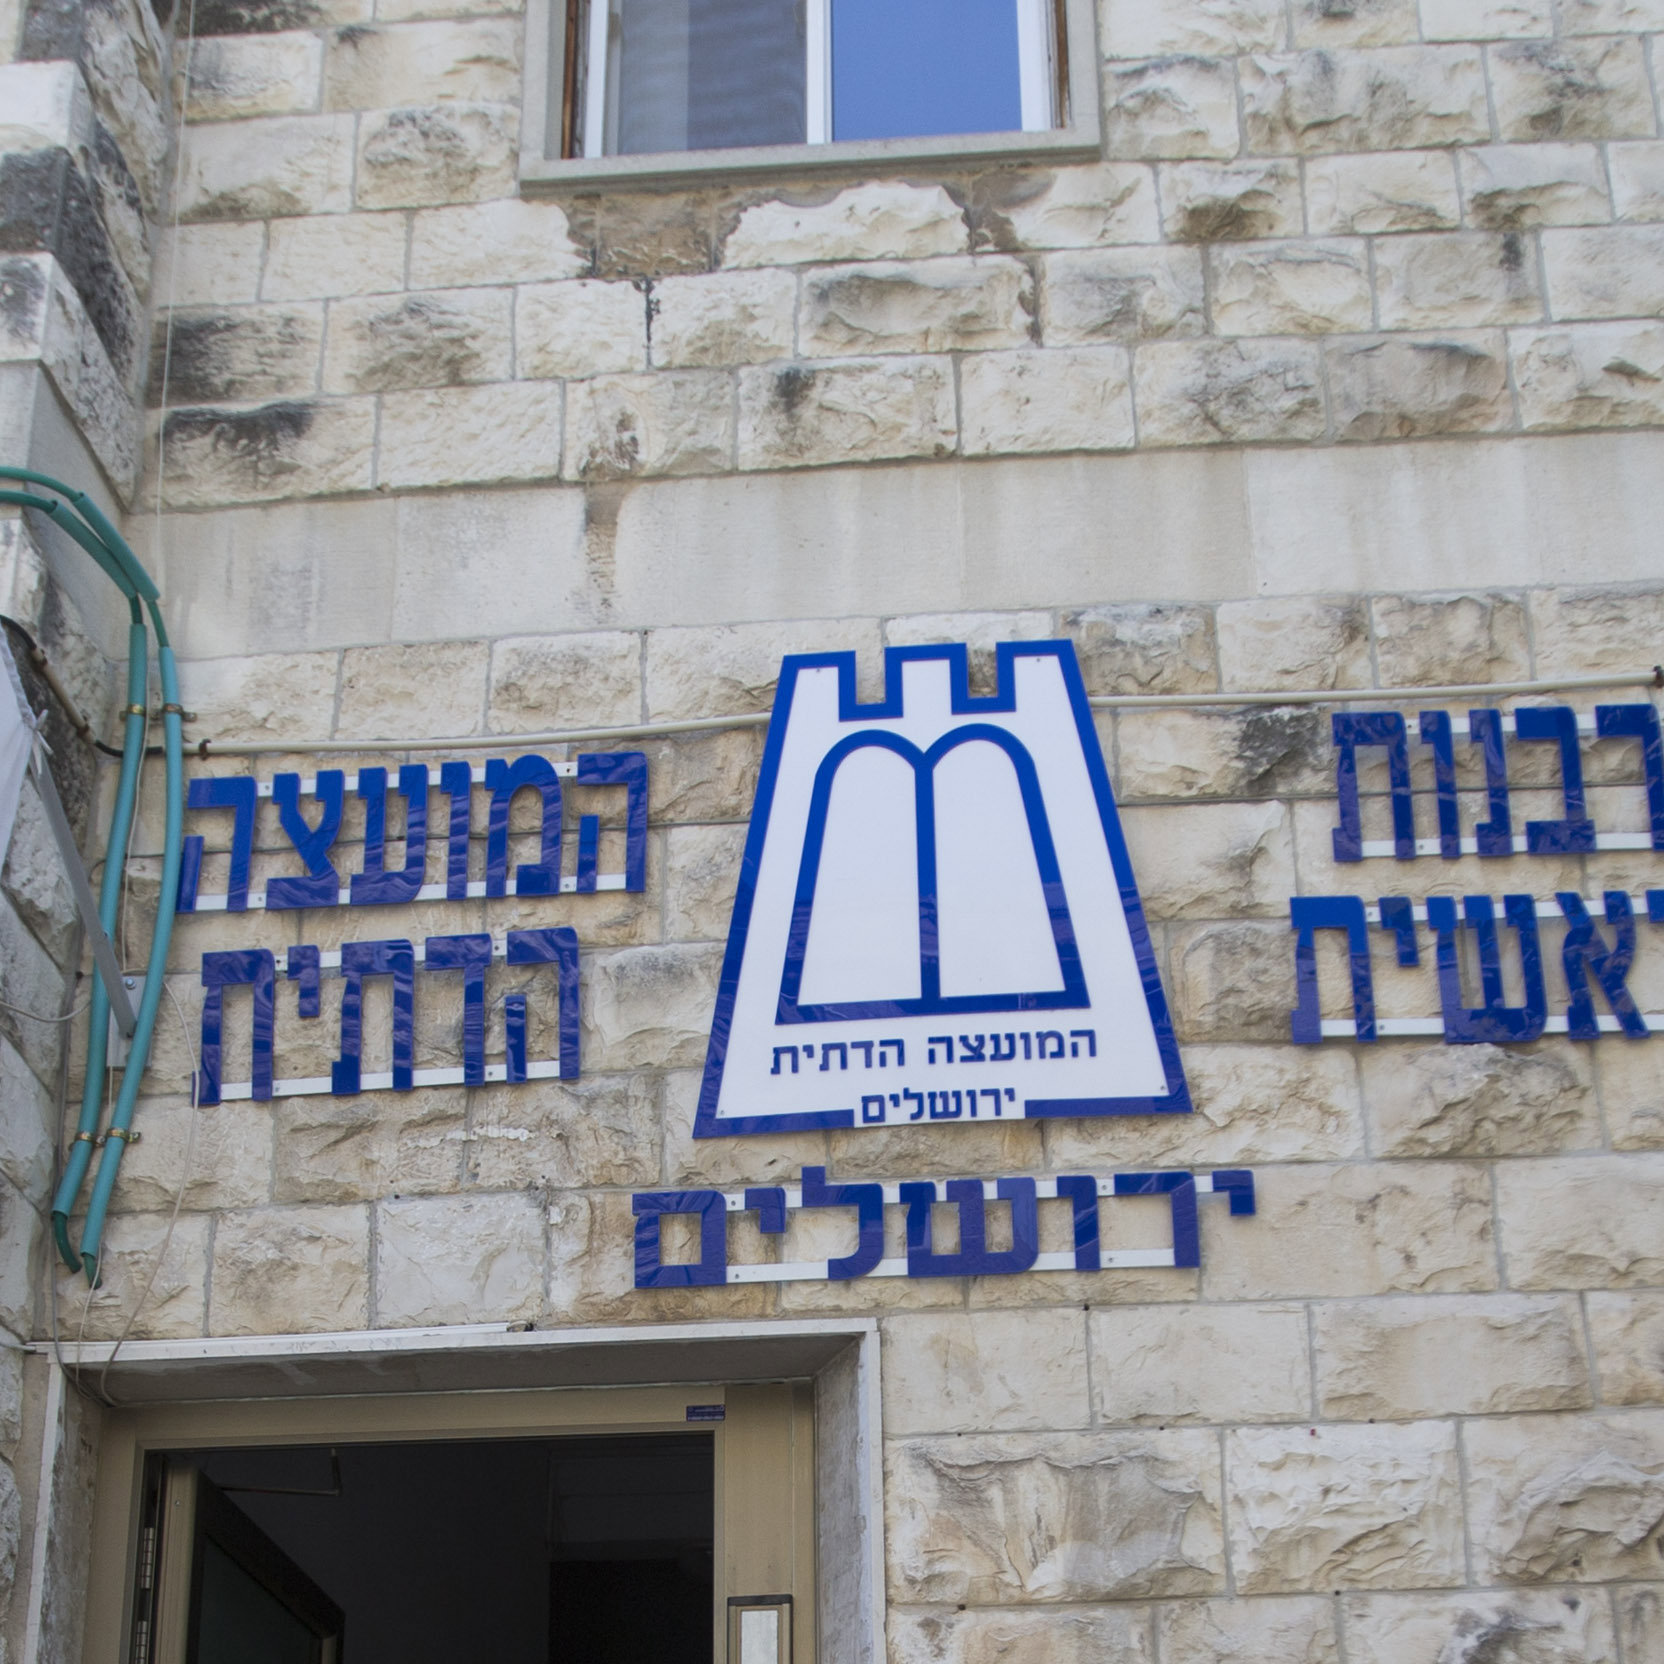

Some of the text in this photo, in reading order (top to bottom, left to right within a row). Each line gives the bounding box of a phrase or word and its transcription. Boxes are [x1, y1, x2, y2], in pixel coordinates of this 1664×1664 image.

[177, 751, 648, 914] המועצה
[192, 926, 581, 1106] הדתית
[770, 1029, 1097, 1076] המועצה הדתית
[860, 1087, 1016, 1124] ירושלים
[631, 1165, 1257, 1289] ירושלים
